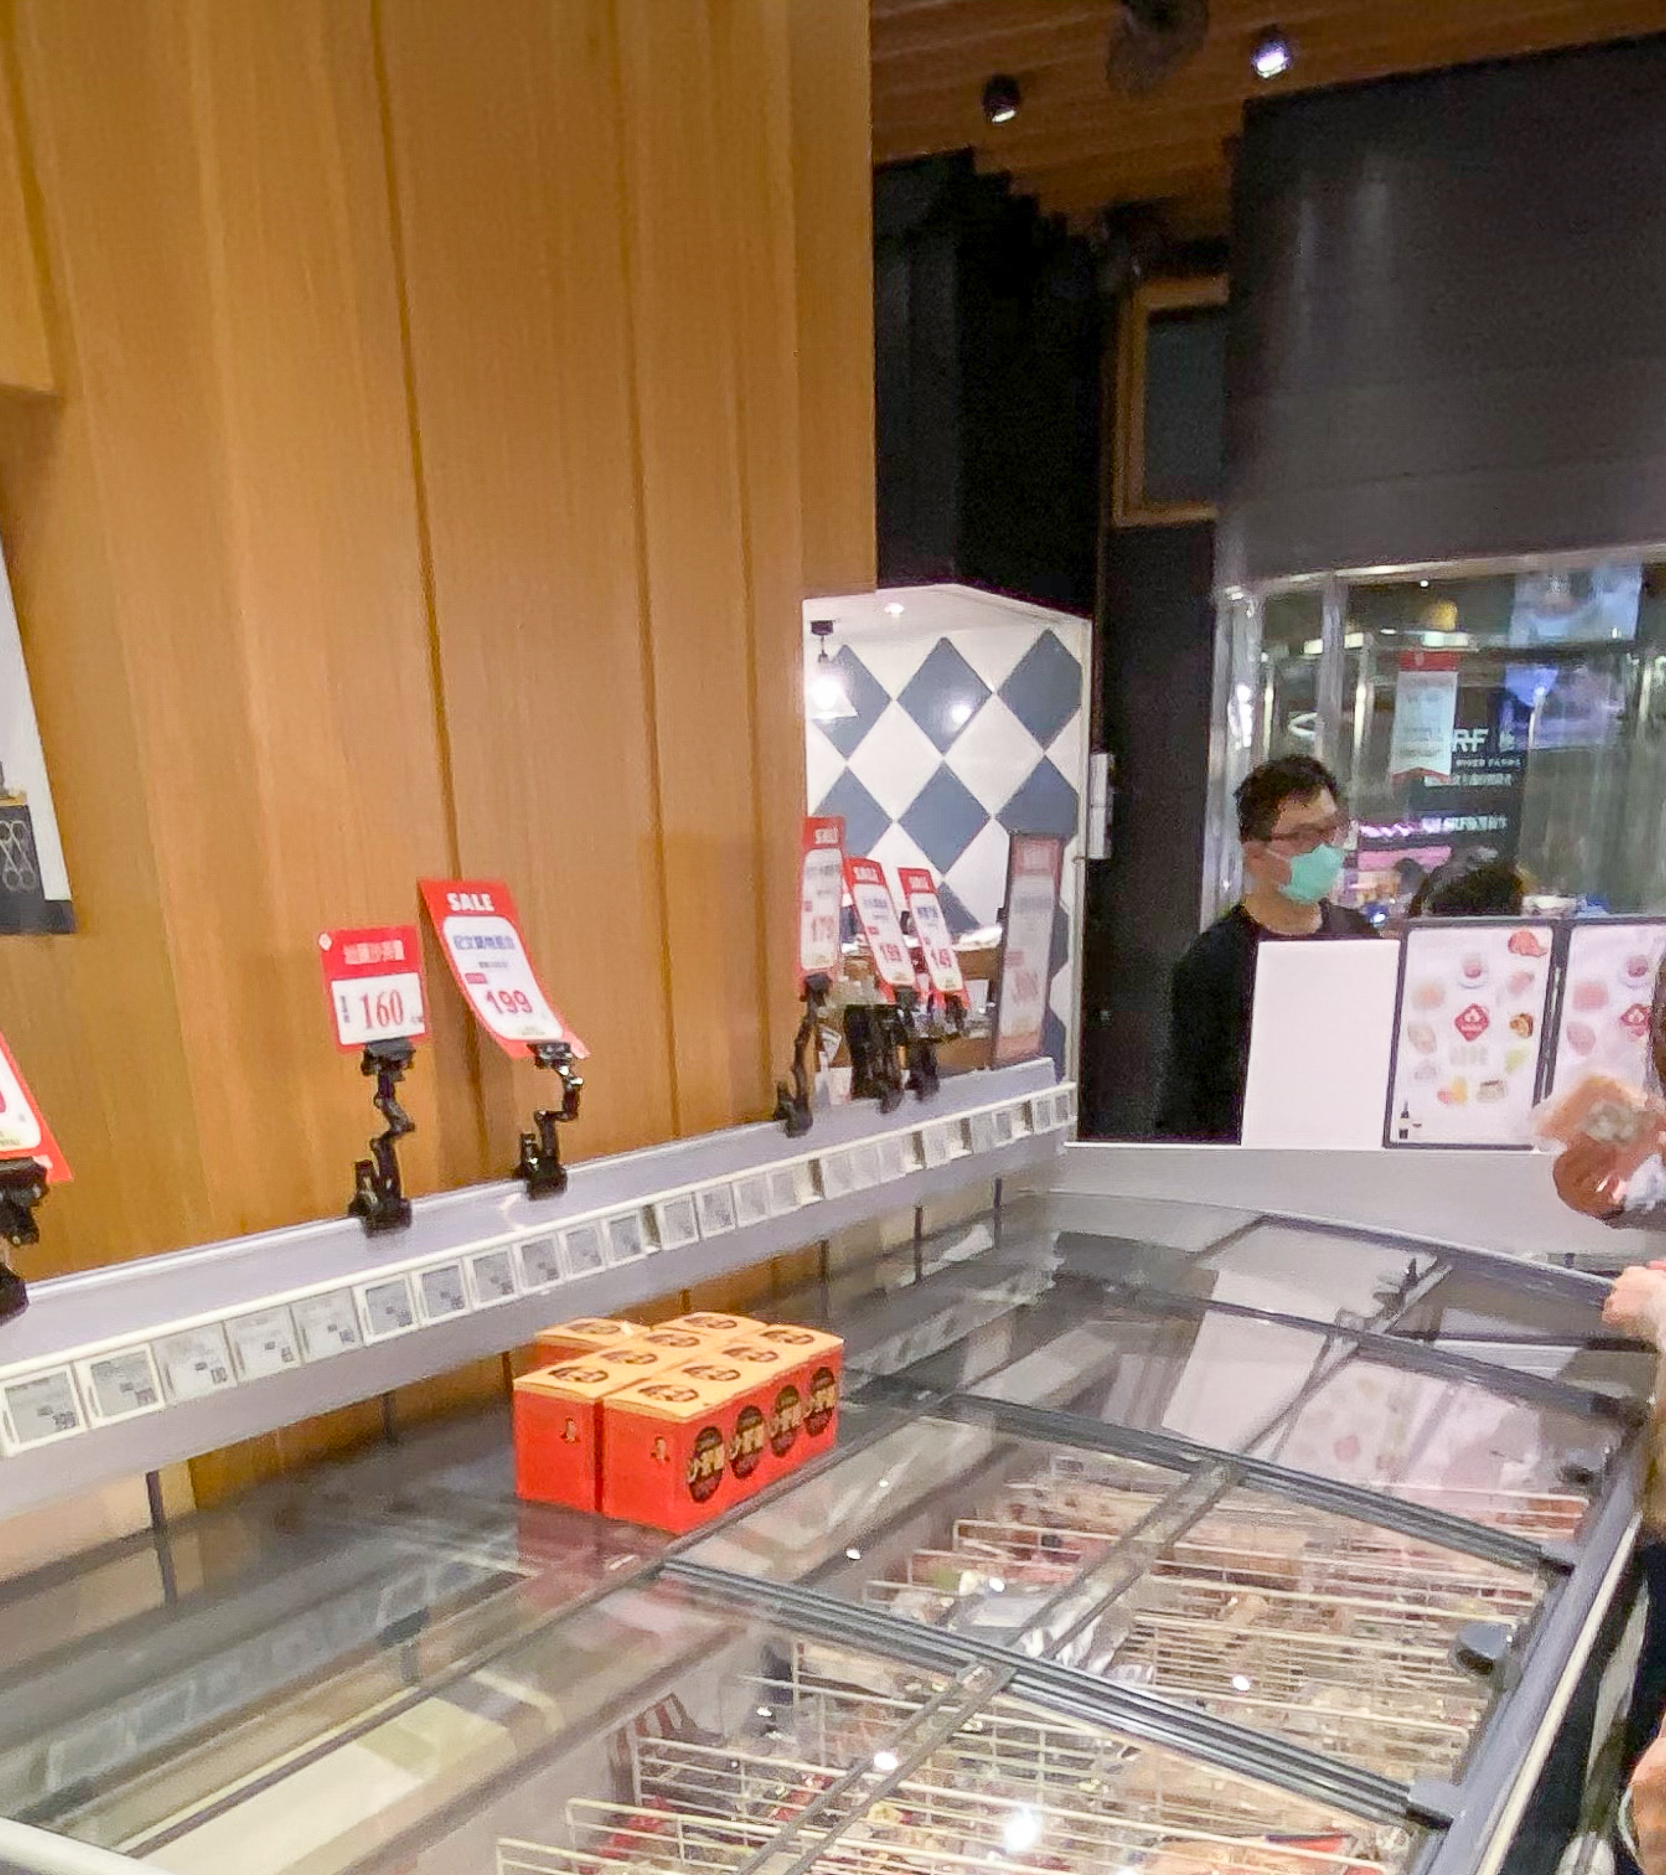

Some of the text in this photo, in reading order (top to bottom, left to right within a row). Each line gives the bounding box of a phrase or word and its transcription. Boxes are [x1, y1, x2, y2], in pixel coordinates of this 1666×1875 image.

[445, 892, 495, 913] SALE
[359, 987, 405, 1031] 160
[485, 988, 534, 1016] 199
